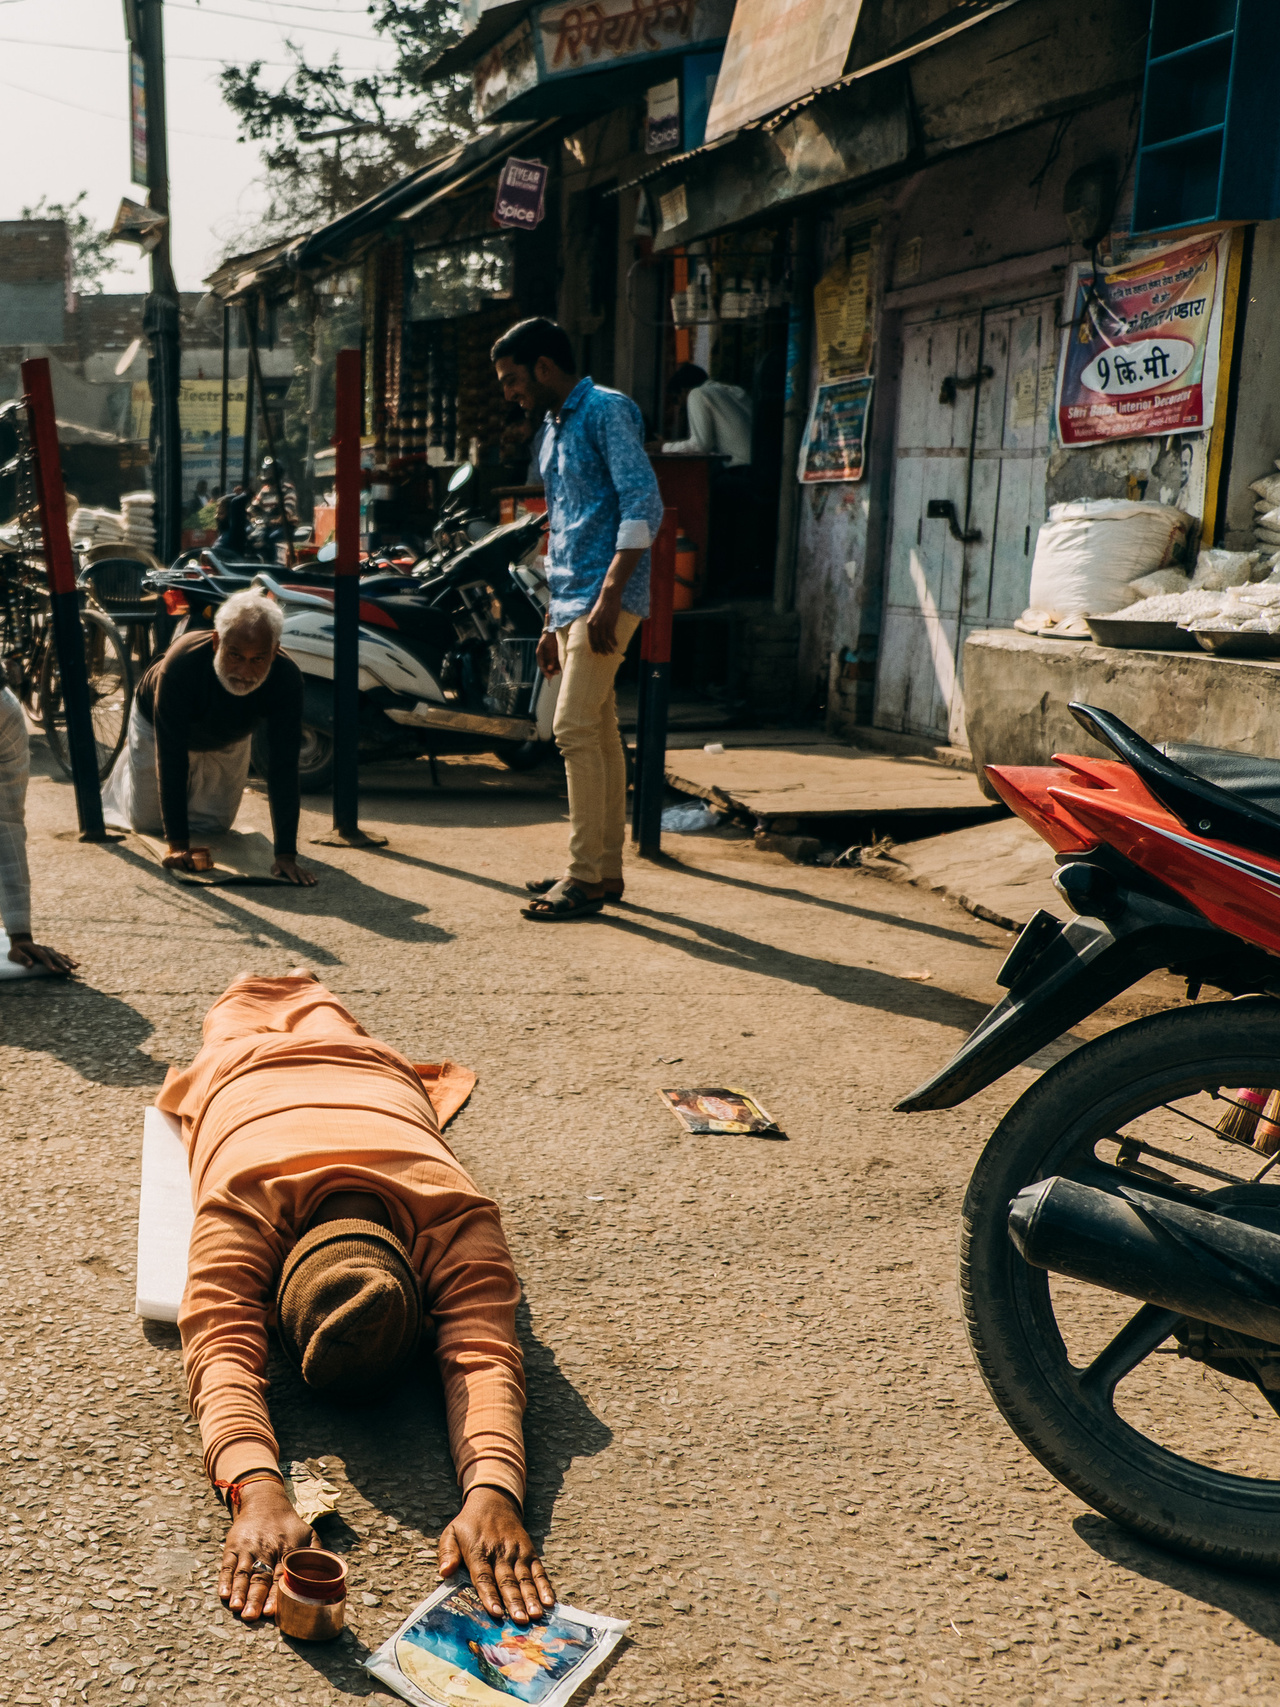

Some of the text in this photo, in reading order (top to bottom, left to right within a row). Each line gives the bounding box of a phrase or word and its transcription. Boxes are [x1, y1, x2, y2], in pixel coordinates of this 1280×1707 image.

[649, 128, 678, 147] Spice
[497, 200, 535, 222] Spice
[1097, 357, 1111, 390] 9
[1067, 404, 1088, 419] Shri
[1119, 398, 1152, 415] Interior
[1154, 389, 1192, 409] Decorator
